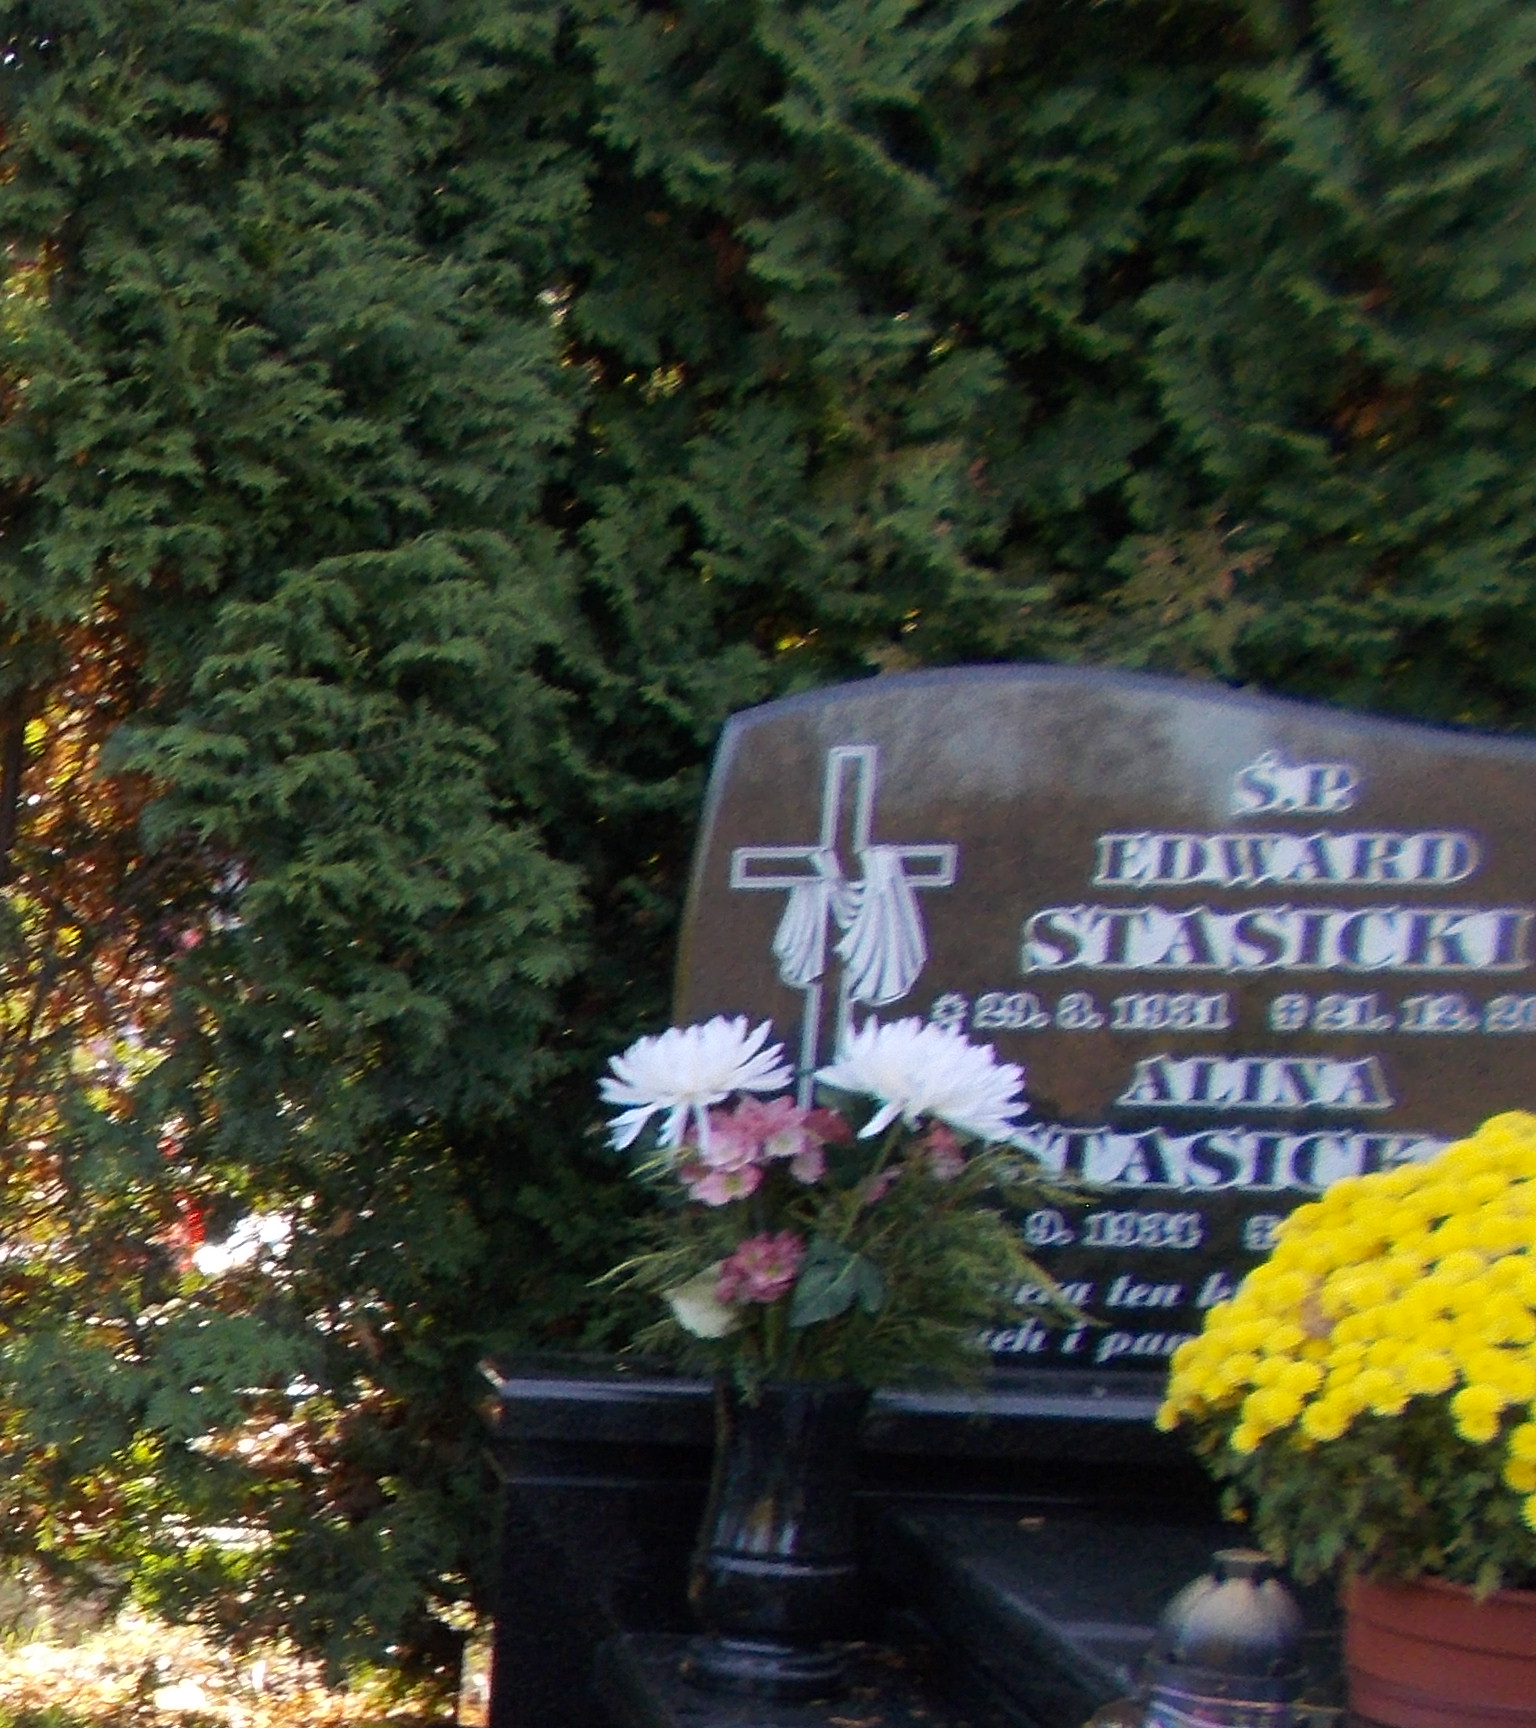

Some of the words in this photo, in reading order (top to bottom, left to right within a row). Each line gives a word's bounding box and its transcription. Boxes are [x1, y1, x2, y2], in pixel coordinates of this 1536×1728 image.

[1092, 830, 1481, 888] EDWARD
[1022, 904, 1535, 973] STASICKI
[1116, 1054, 1397, 1111] ALINA
